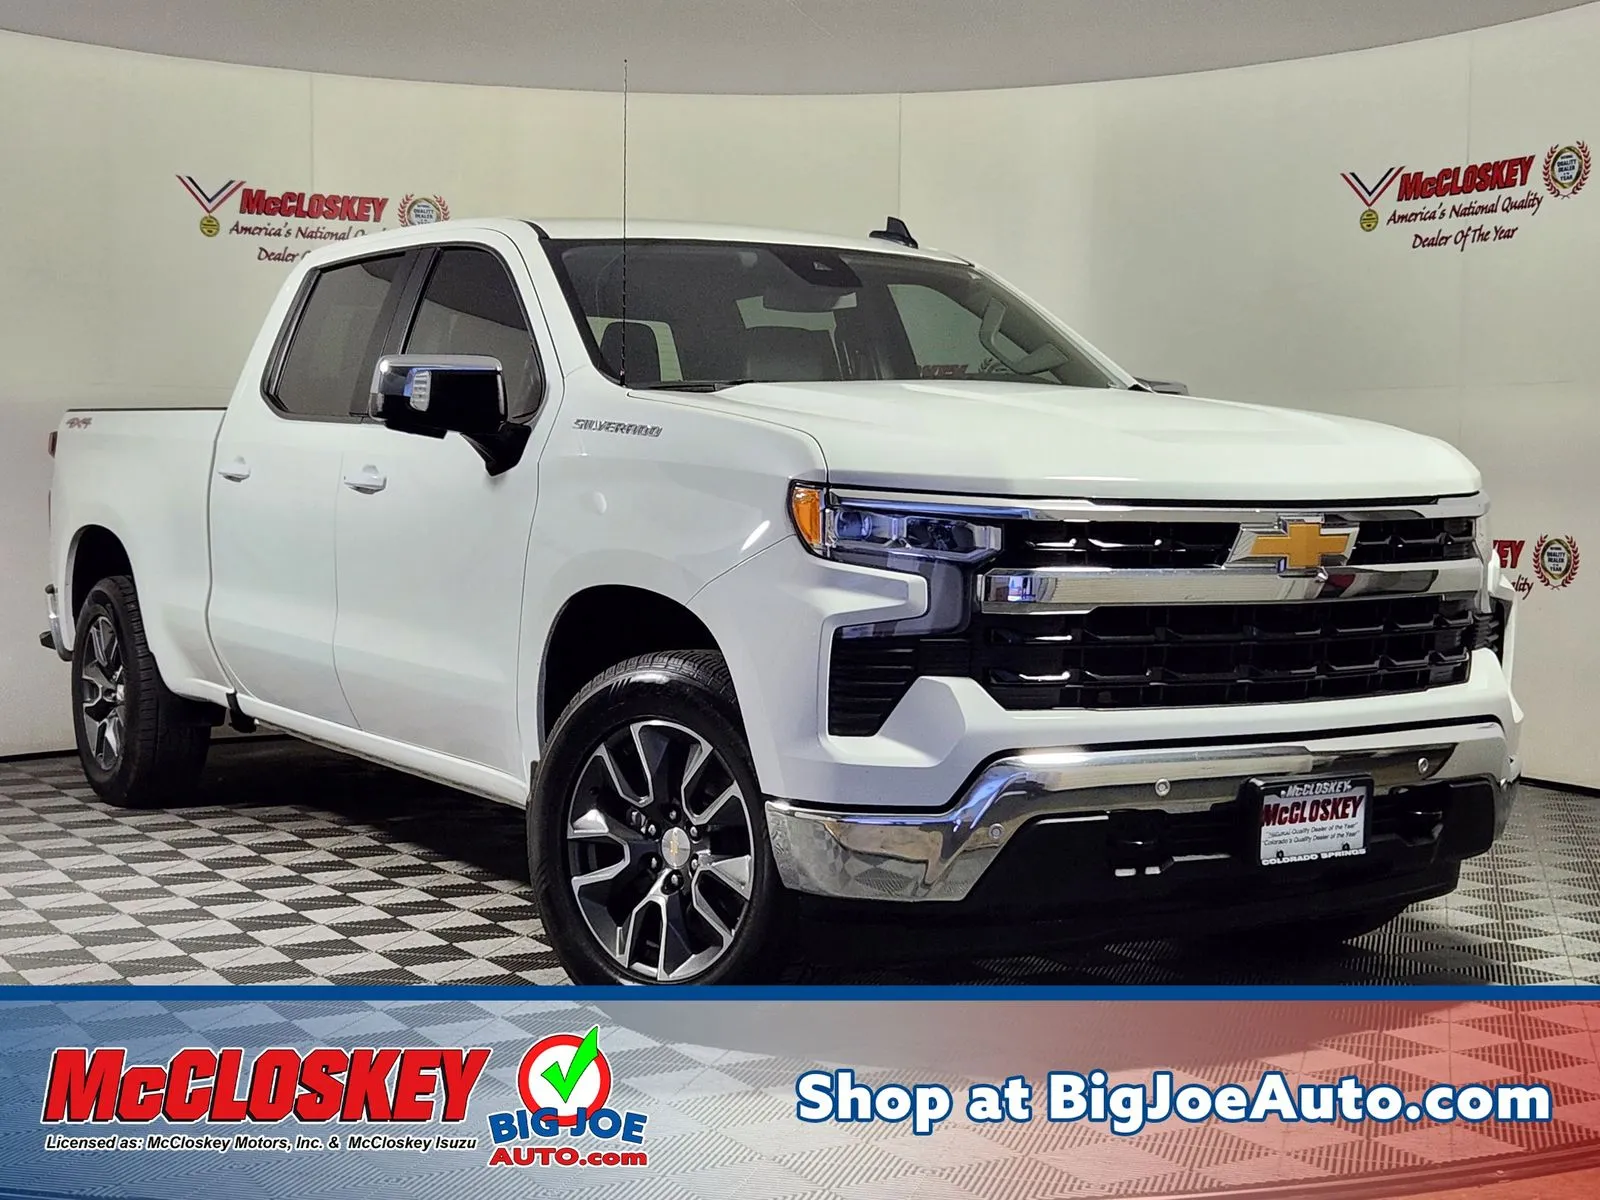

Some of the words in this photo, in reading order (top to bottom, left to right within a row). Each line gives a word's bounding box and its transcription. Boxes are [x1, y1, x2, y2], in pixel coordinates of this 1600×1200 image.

[1397, 155, 1536, 201] McCLOSKEY
[239, 188, 389, 223] McCLOSKEY
[1386, 202, 1446, 226] America's
[1449, 195, 1502, 219] National
[1501, 190, 1544, 216] Quality
[229, 220, 292, 239] America's
[295, 226, 353, 241] National
[1412, 229, 1452, 249] Dealer
[1454, 226, 1472, 252] Of
[1471, 224, 1491, 244] The
[1493, 225, 1519, 242] Year
[257, 246, 300, 263] Dealer
[572, 418, 663, 438] SILVERADO
[1262, 795, 1364, 827] McCLOSKEY
[1261, 853, 1319, 866] COLORADO
[1320, 848, 1366, 860] SPRINGS
